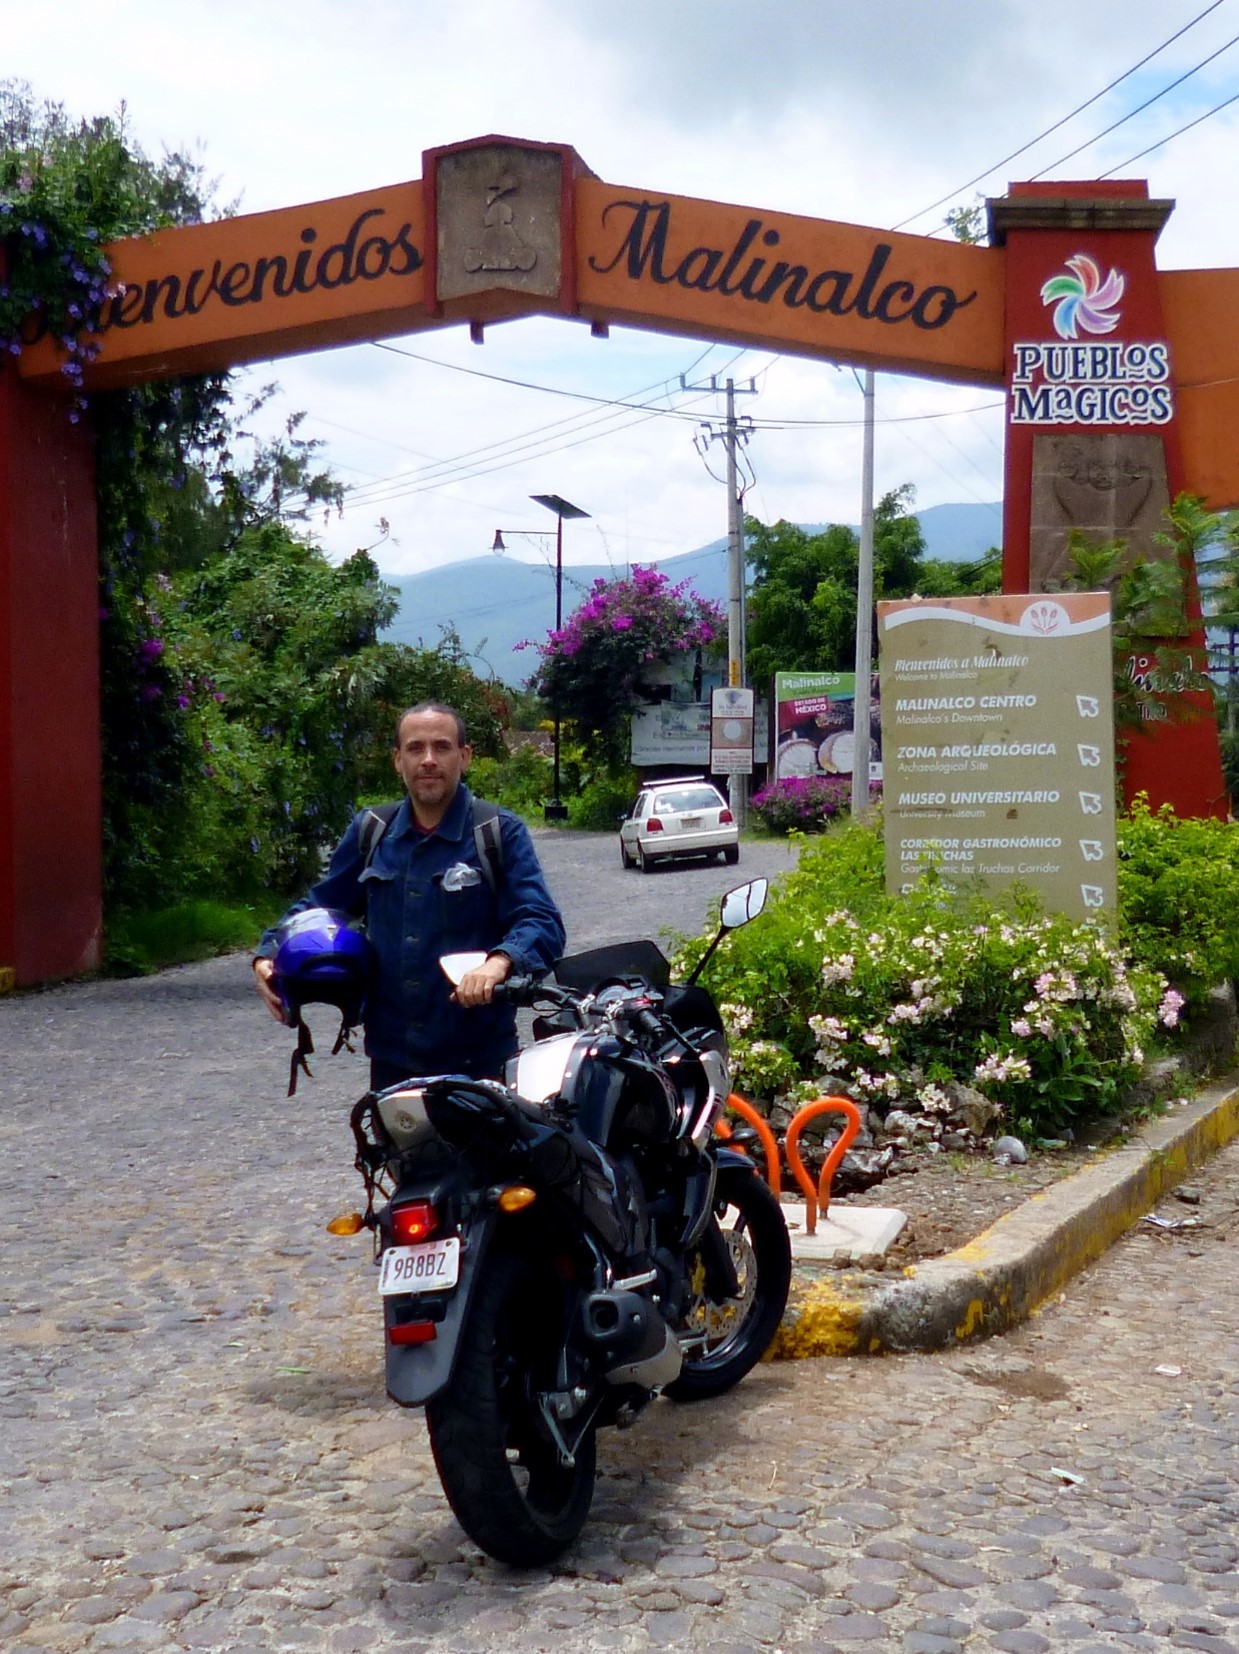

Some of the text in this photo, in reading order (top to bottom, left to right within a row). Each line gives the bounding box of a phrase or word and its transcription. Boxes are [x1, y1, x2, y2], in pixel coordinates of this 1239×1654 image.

[588, 199, 977, 330] Malinalco
[895, 655, 1029, 672] Bienvenidos a Malinalco
[782, 676, 840, 689] Malinalco
[896, 695, 1037, 711] MALINALCO CENTRO
[952, 713, 1003, 723] Downtown
[897, 741, 1057, 759] ZONA ARQUEOLÓGICA
[897, 761, 989, 774] Archaeological Site
[898, 790, 1060, 805] MUSEO UNIVERSITARIO
[963, 835, 1062, 849] GASTRONÓMICO
[900, 851, 919, 861] LAS
[979, 862, 1014, 873] Truchas
[1018, 863, 1060, 873] Corridor
